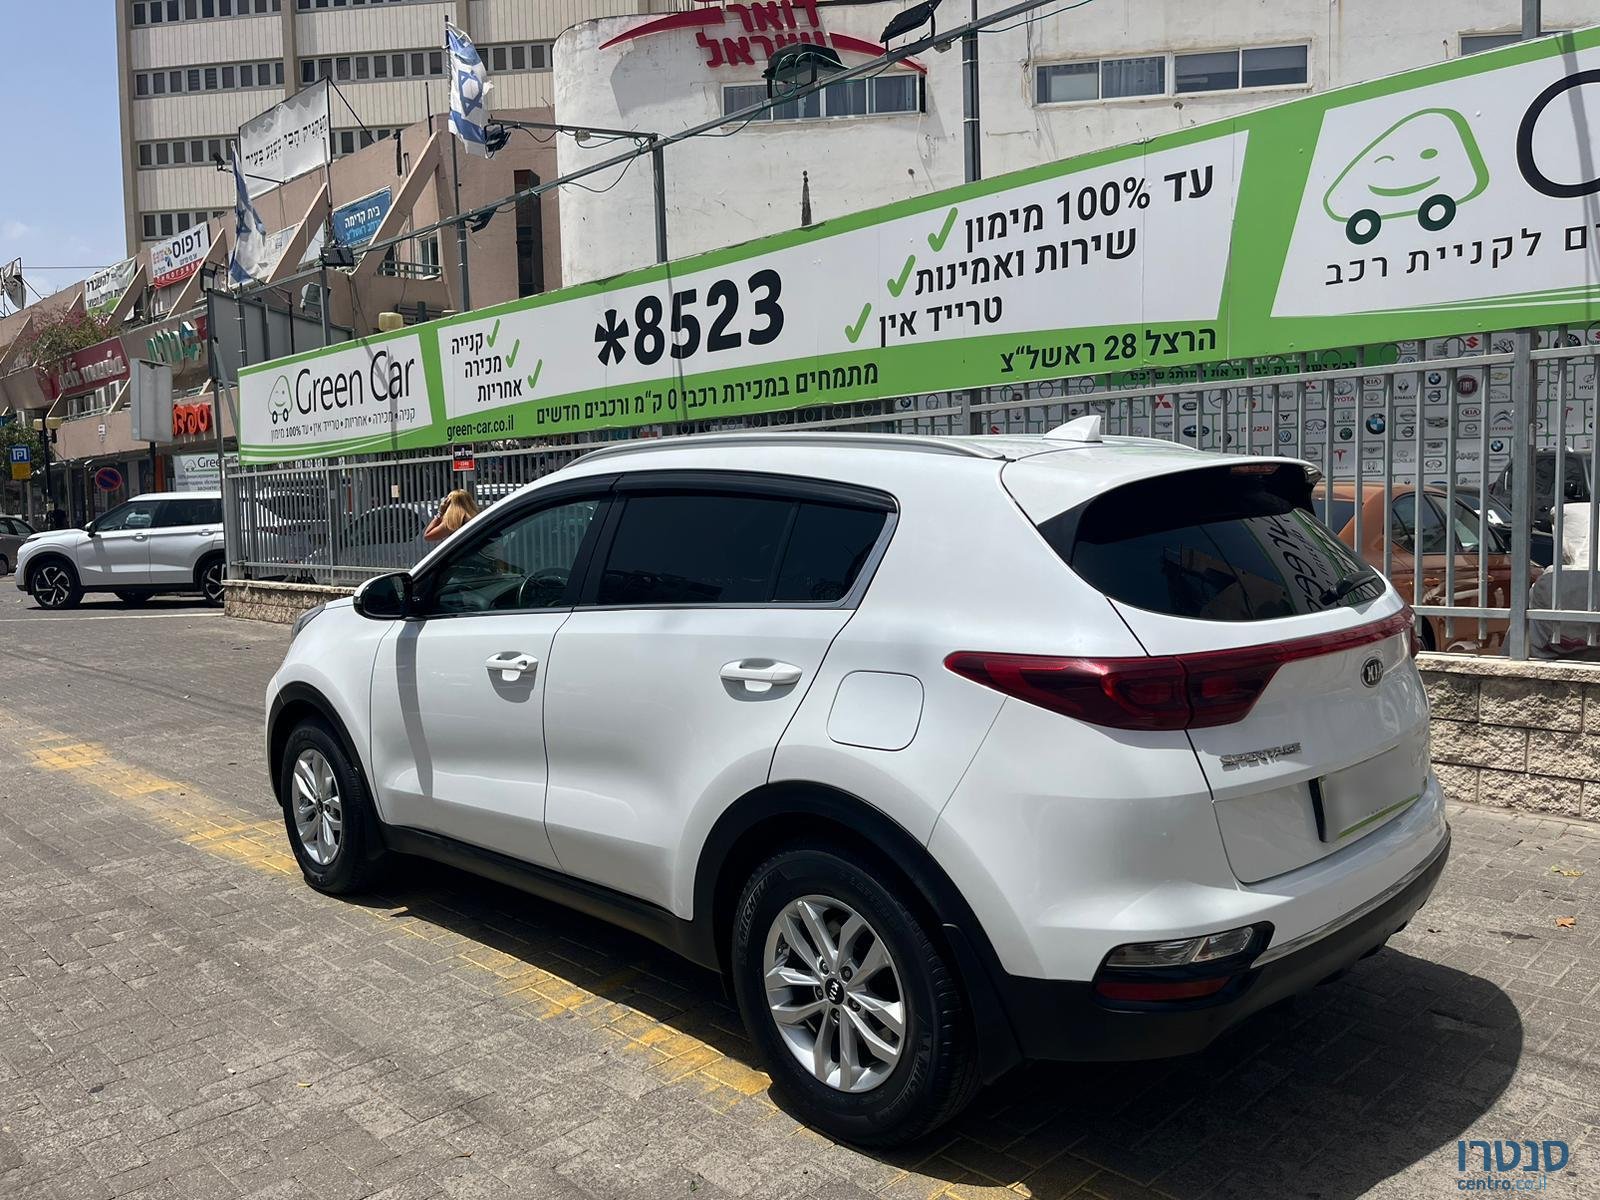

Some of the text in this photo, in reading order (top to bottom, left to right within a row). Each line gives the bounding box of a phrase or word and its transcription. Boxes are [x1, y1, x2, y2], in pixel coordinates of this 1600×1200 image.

[966, 165, 1213, 253] עד 100% מימון
[172, 231, 201, 258] דפוס
[1406, 228, 1542, 274] לקניית
[915, 228, 1137, 296] שירות ואמינות
[1325, 256, 1388, 286] רכב
[879, 296, 1002, 348] טרייד אין
[451, 332, 484, 355] קנייה
[1104, 333, 1137, 361] 28
[1145, 327, 1216, 357] הרצל
[465, 355, 502, 379] מכירה
[795, 363, 878, 393] מתמחים
[296, 351, 415, 415] Green Car
[478, 377, 523, 403] אחריות
[723, 377, 789, 403] במכירת
[585, 396, 629, 417] ורכבים
[684, 389, 718, 408] רכבי
[323, 419, 340, 431] טרייד
[345, 415, 367, 429] אחריות
[372, 411, 393, 425] מכירה
[536, 405, 580, 424] חדשים
[286, 427, 301, 437] 100%
[447, 415, 514, 441] green-car.co.il
